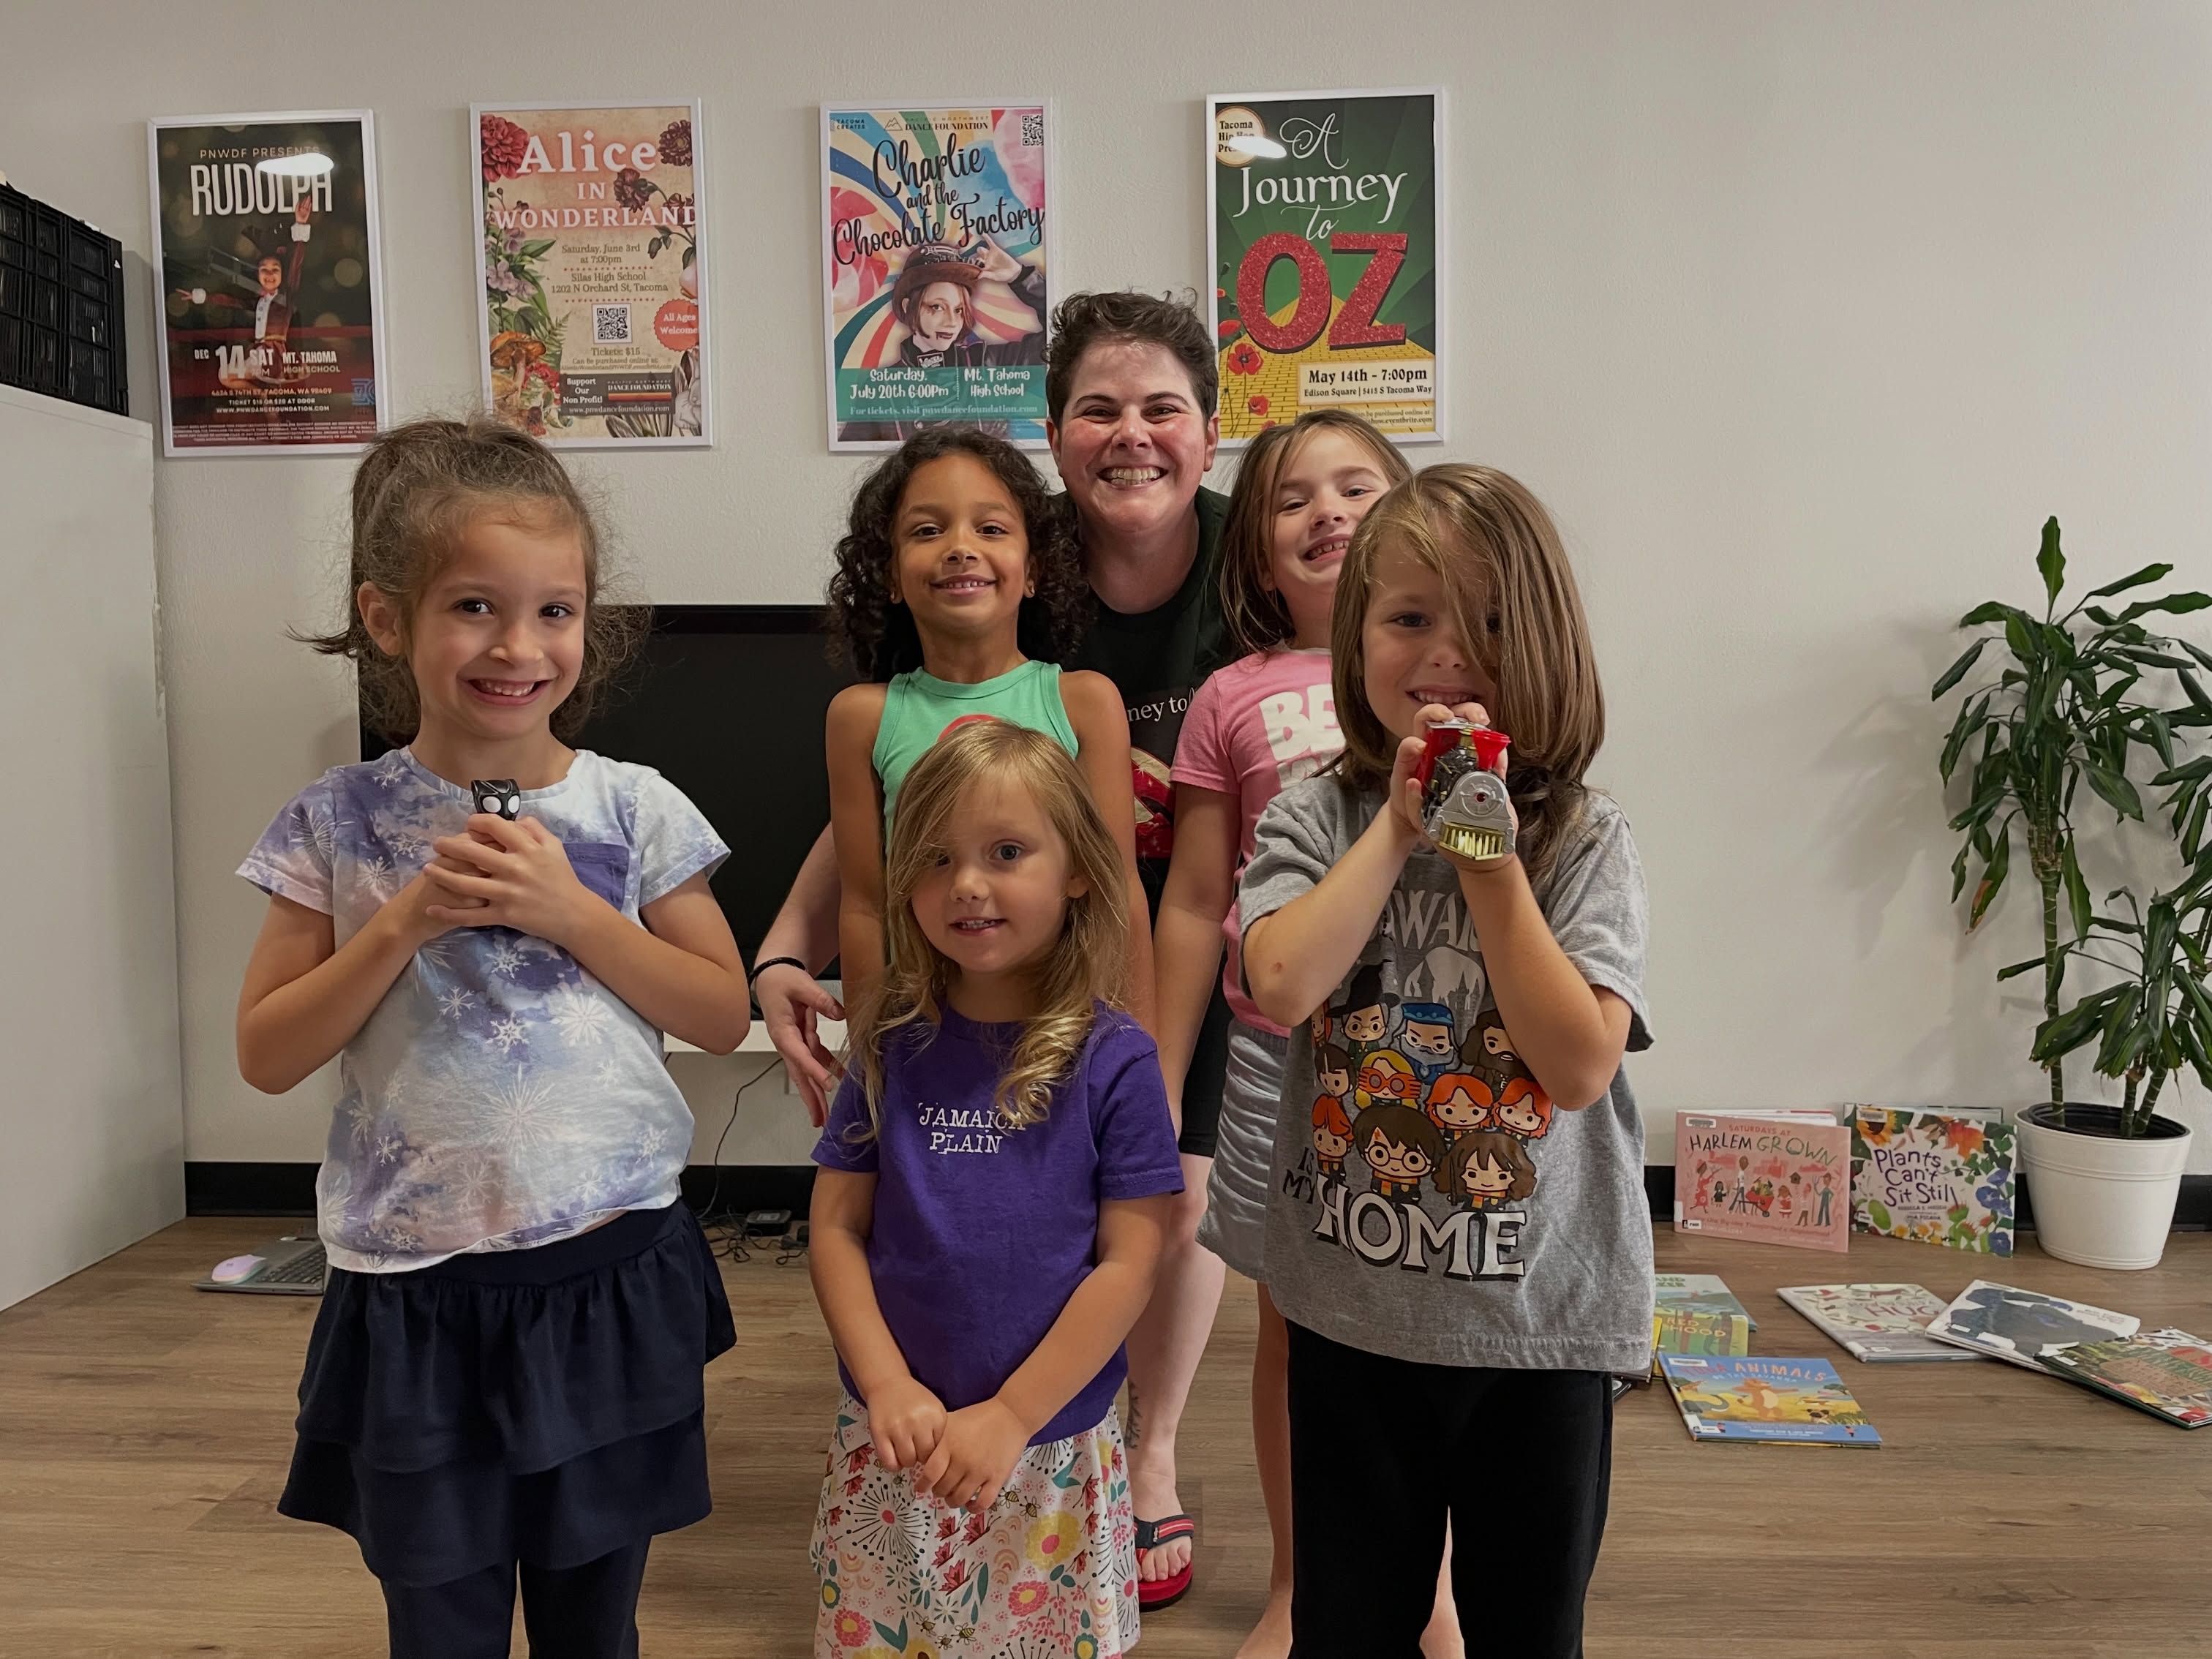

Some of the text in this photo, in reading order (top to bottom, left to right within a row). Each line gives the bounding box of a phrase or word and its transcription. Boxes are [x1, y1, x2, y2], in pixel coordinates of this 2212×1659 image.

[935, 122, 988, 130] FOUNDATION
[1219, 121, 1253, 129] Tacoma
[1279, 113, 1349, 170] A
[200, 147, 247, 159] PNWDF
[516, 129, 656, 173] Alice
[873, 132, 985, 198] Charlie
[190, 162, 333, 216] RUDOLPH
[578, 182, 606, 199] IN
[906, 181, 959, 209] and the
[1233, 168, 1408, 224] Journey
[493, 206, 696, 230] WONDERLAND
[833, 193, 1045, 266] Chocolate Factory
[562, 244, 640, 255] Saturday, June 3rd
[591, 256, 622, 265] 7:00pm
[571, 271, 646, 283] Silas High School
[552, 283, 669, 293] 1202 N Orchard St, Tacoma
[1237, 232, 1408, 354] OZ
[663, 312, 696, 323] All Ages
[660, 326, 698, 334] Welcome
[591, 347, 641, 356] Tickets: $15
[194, 345, 337, 379] DEC 14 SAT MT. TAHOMA
[283, 365, 341, 375] HIGH SCHOOL
[566, 377, 596, 386] Support
[964, 367, 985, 382] Mt.
[987, 367, 1030, 382] Tahoma
[1309, 370, 1336, 385] May
[1341, 369, 1368, 382] 14th
[1381, 369, 1427, 383] 7:00pm
[850, 384, 876, 399] July
[878, 384, 906, 398] 20th
[970, 384, 991, 397] High
[993, 383, 1024, 396] School
[1304, 388, 1330, 396] Edison
[1331, 388, 1357, 397] Square
[1380, 386, 1385, 394] S
[1386, 385, 1415, 394] Tacoma
[1416, 385, 1432, 394] Way
[1168, 696, 1187, 714] to
[1728, 1124, 1777, 1135] SATURDAYS
[929, 1131, 1004, 1155] PLAIN
[1689, 1132, 1837, 1165] HARLEM GROWN
[1874, 1148, 1941, 1173] Plants
[1884, 1168, 1938, 1186] Can't
[1282, 1169, 1316, 1205] MY
[1884, 1182, 1959, 1210] Sit Still
[1312, 1170, 1527, 1282] HOME
[1865, 1306, 1940, 1317] HUG
[1667, 1317, 1699, 1327] RED
[1670, 1324, 1727, 1337] HOOD
[1734, 1362, 1827, 1382] ANIMALS
